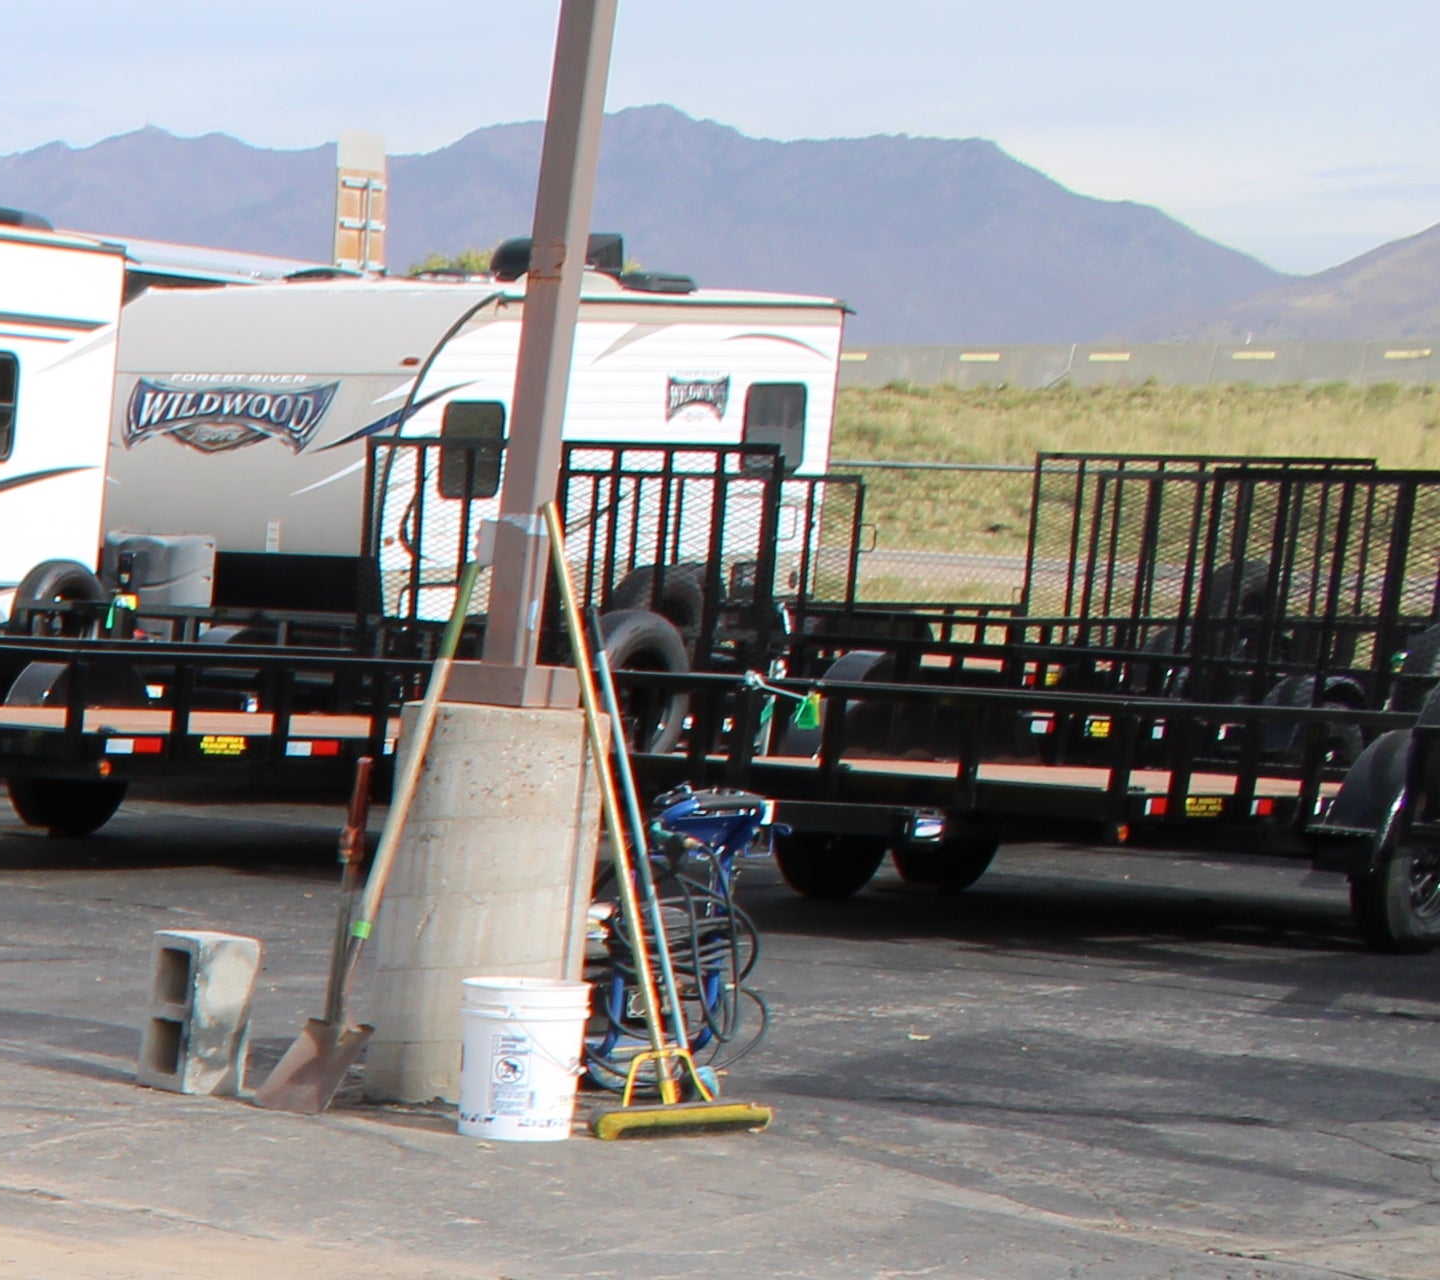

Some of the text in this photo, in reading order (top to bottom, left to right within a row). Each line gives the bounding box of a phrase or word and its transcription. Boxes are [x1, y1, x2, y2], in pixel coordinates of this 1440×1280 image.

[170, 373, 307, 385] FOREST RIVER
[138, 391, 315, 432] WILDWOOD
